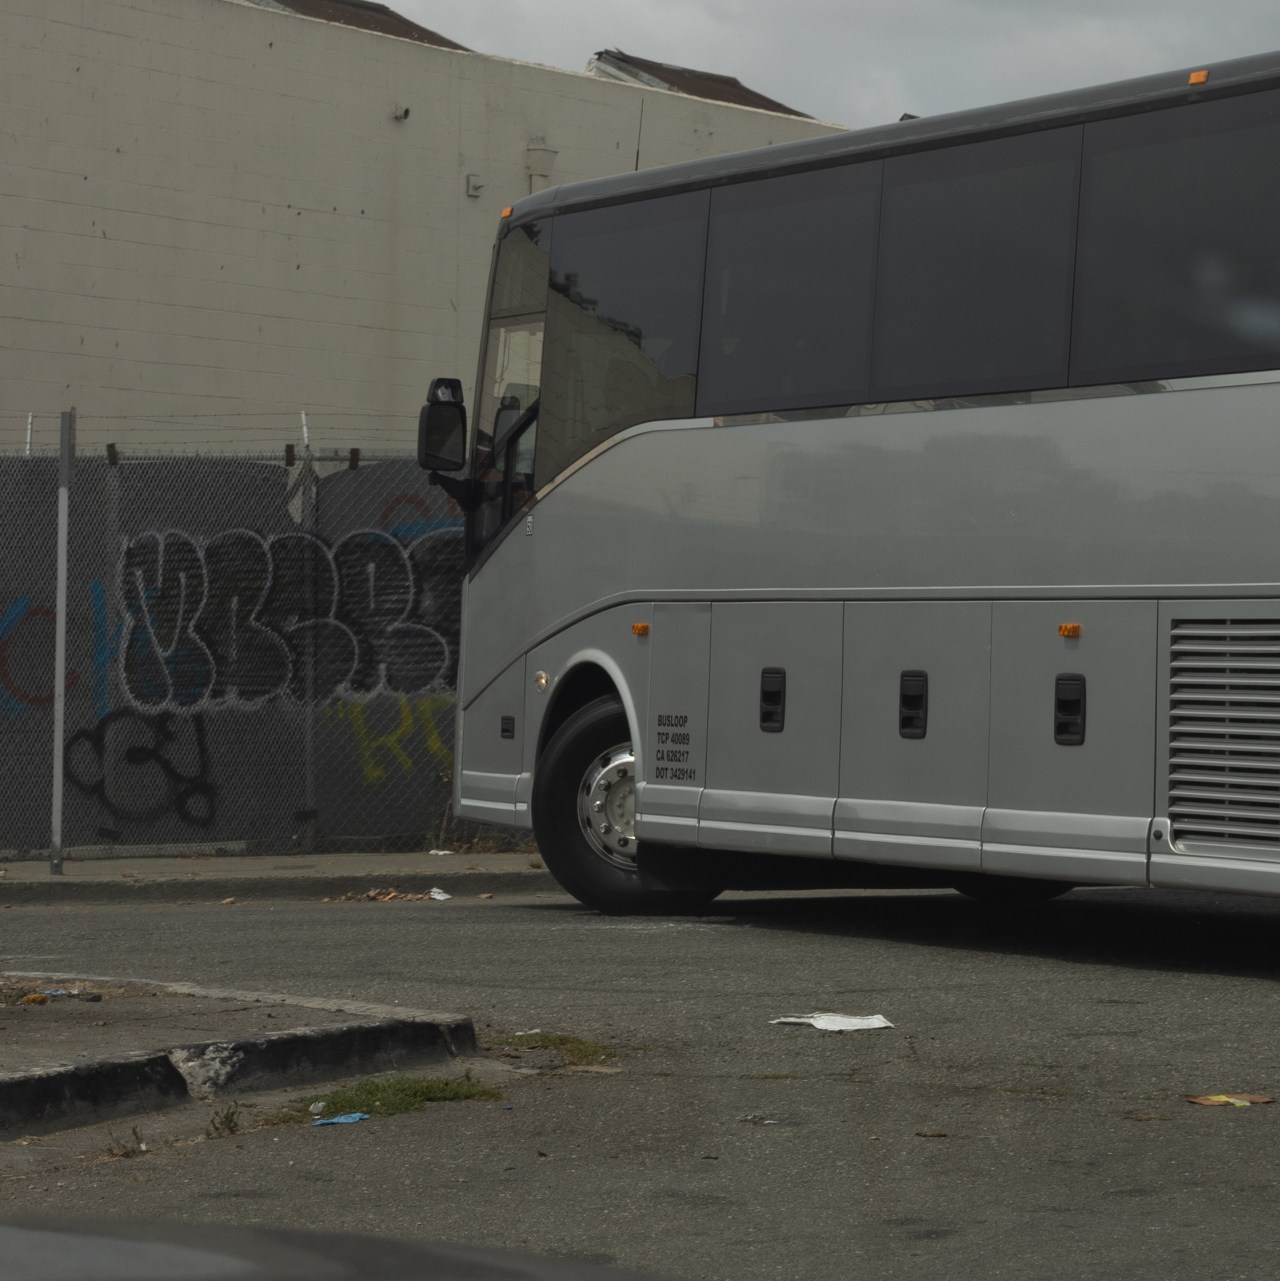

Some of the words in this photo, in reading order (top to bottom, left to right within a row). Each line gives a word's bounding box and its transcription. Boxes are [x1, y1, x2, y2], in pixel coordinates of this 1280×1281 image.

[657, 714, 688, 728] BUSLOOP
[657, 731, 670, 744] TCP
[670, 732, 690, 745] 40089
[655, 749, 665, 762] CA
[666, 749, 689, 763] 626217
[655, 766, 669, 779] DOT
[669, 767, 696, 781] 3429141
